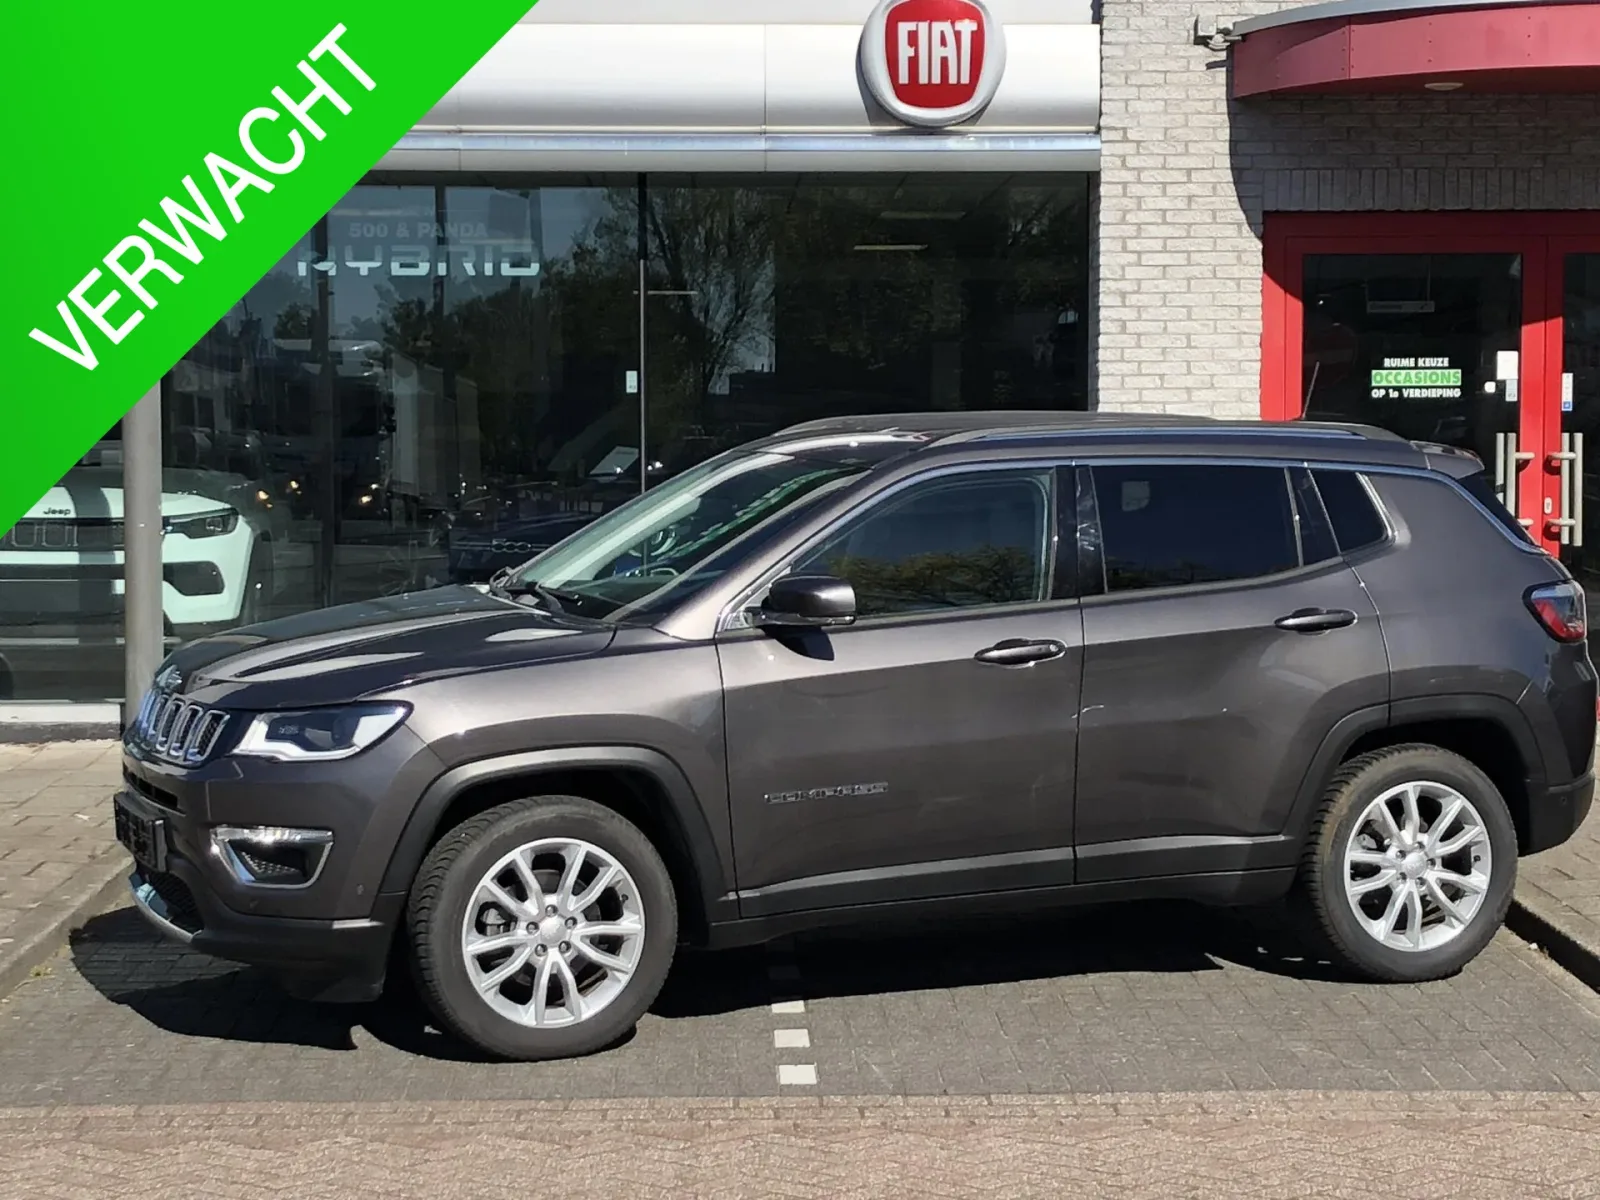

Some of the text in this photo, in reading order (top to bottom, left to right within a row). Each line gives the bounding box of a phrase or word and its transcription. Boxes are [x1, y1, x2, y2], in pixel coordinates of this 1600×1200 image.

[897, 19, 978, 85] FIAT
[350, 223, 488, 238] 500 & PANDA
[297, 244, 540, 277] HYBRID
[1384, 357, 1449, 367] RUIME KEUZE
[1373, 371, 1461, 385] OCCASIONS
[1371, 389, 1386, 398] OP
[1402, 388, 1461, 398] VERDIEPING
[43, 507, 71, 516] Jeep
